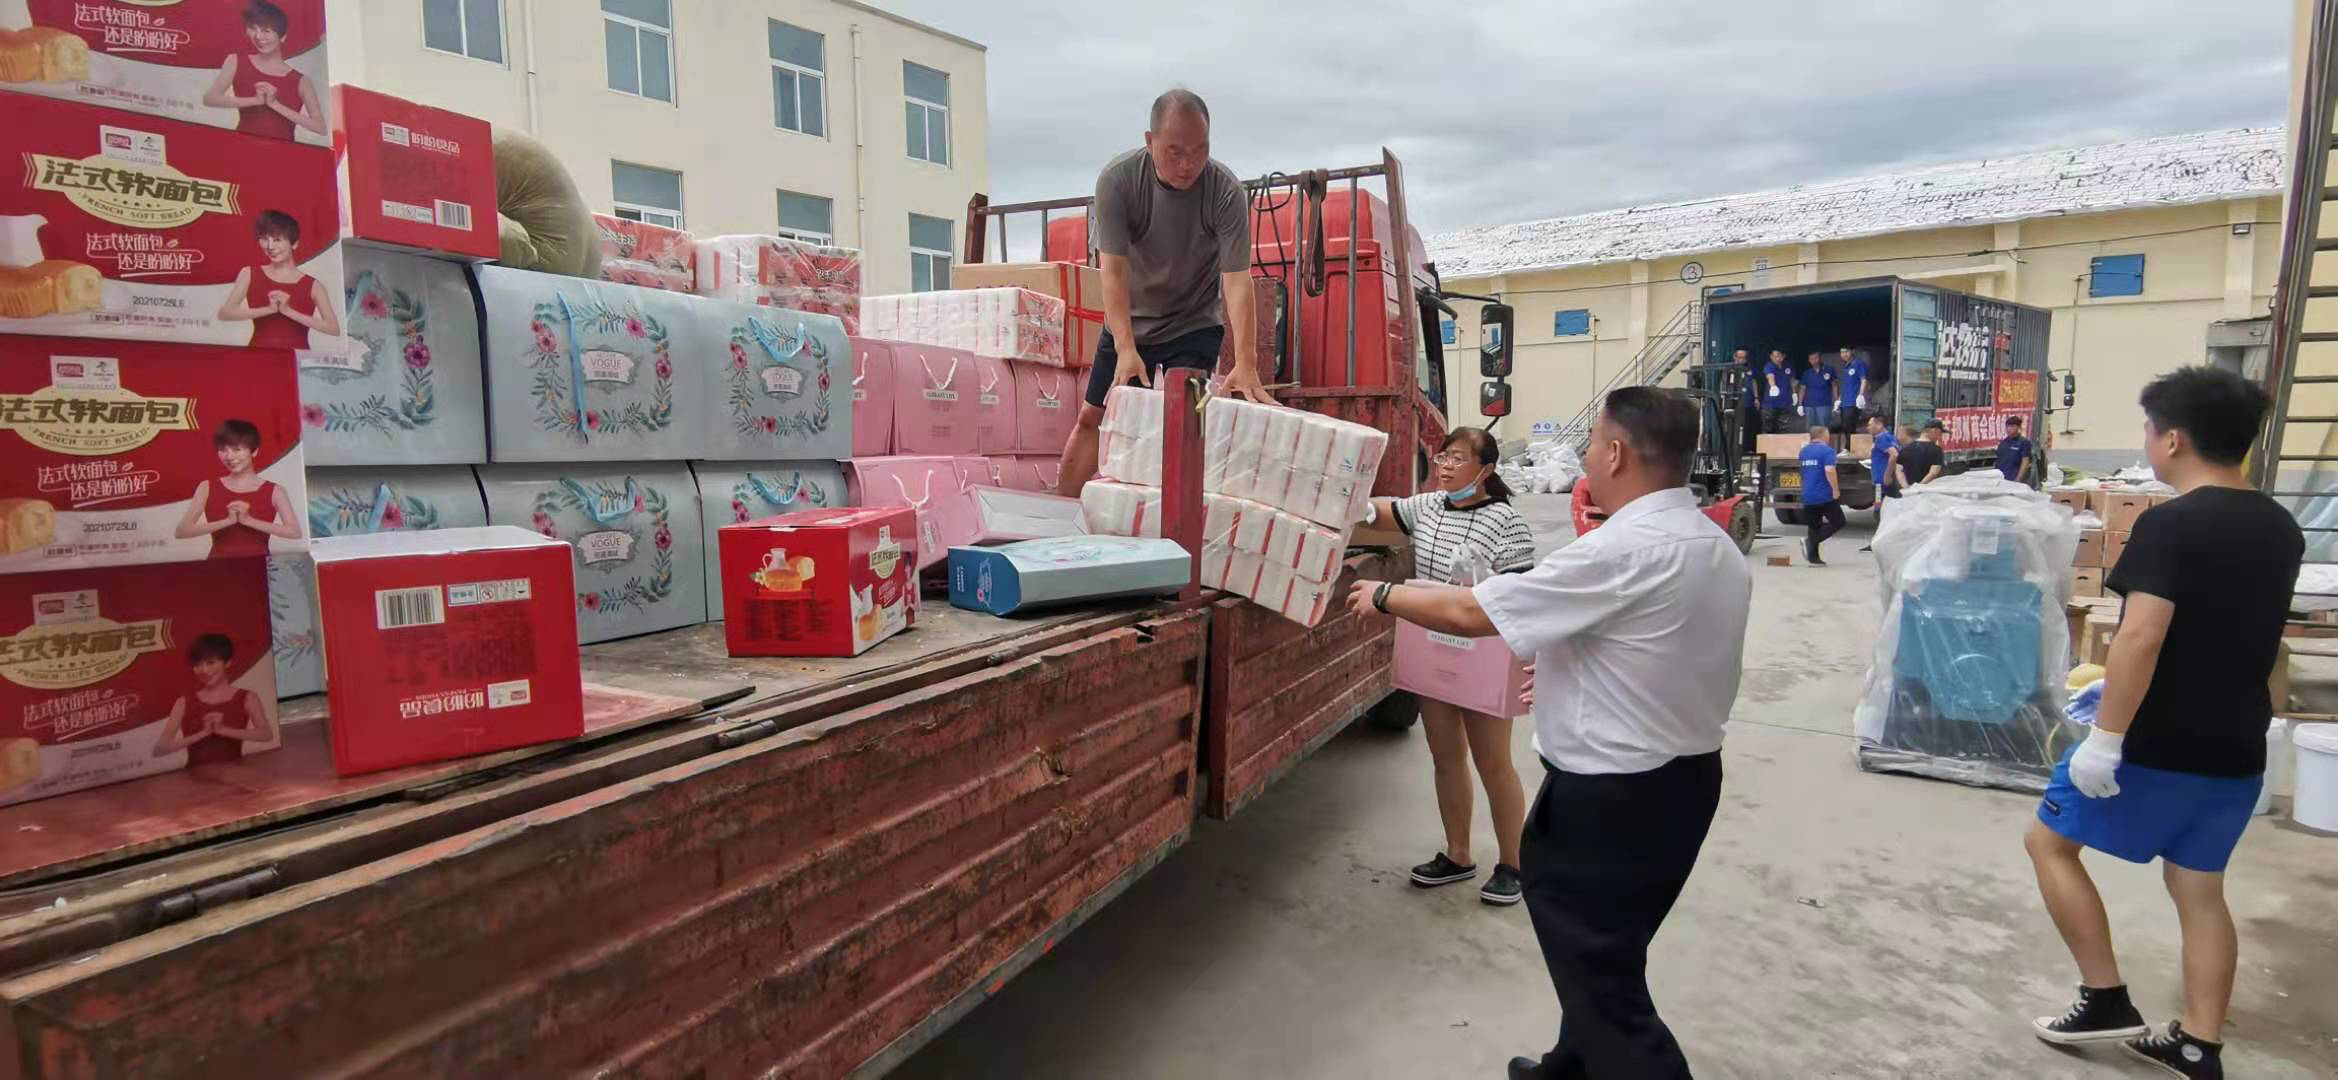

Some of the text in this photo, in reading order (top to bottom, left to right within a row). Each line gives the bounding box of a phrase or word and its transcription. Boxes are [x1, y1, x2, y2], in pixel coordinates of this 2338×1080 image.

[75, 3, 150, 26] 法式软面包
[104, 26, 179, 51] 还是盼盼好
[42, 158, 223, 207] 法式软面包
[87, 233, 163, 251] 法式软面包
[118, 252, 194, 271] 还是盼盼好
[590, 357, 624, 369] VOGUE
[0, 398, 180, 425] 法式软面包
[38, 460, 118, 485] 法式软面包
[70, 475, 148, 501] 还是盼盼好
[590, 537, 622, 548] VOGUE
